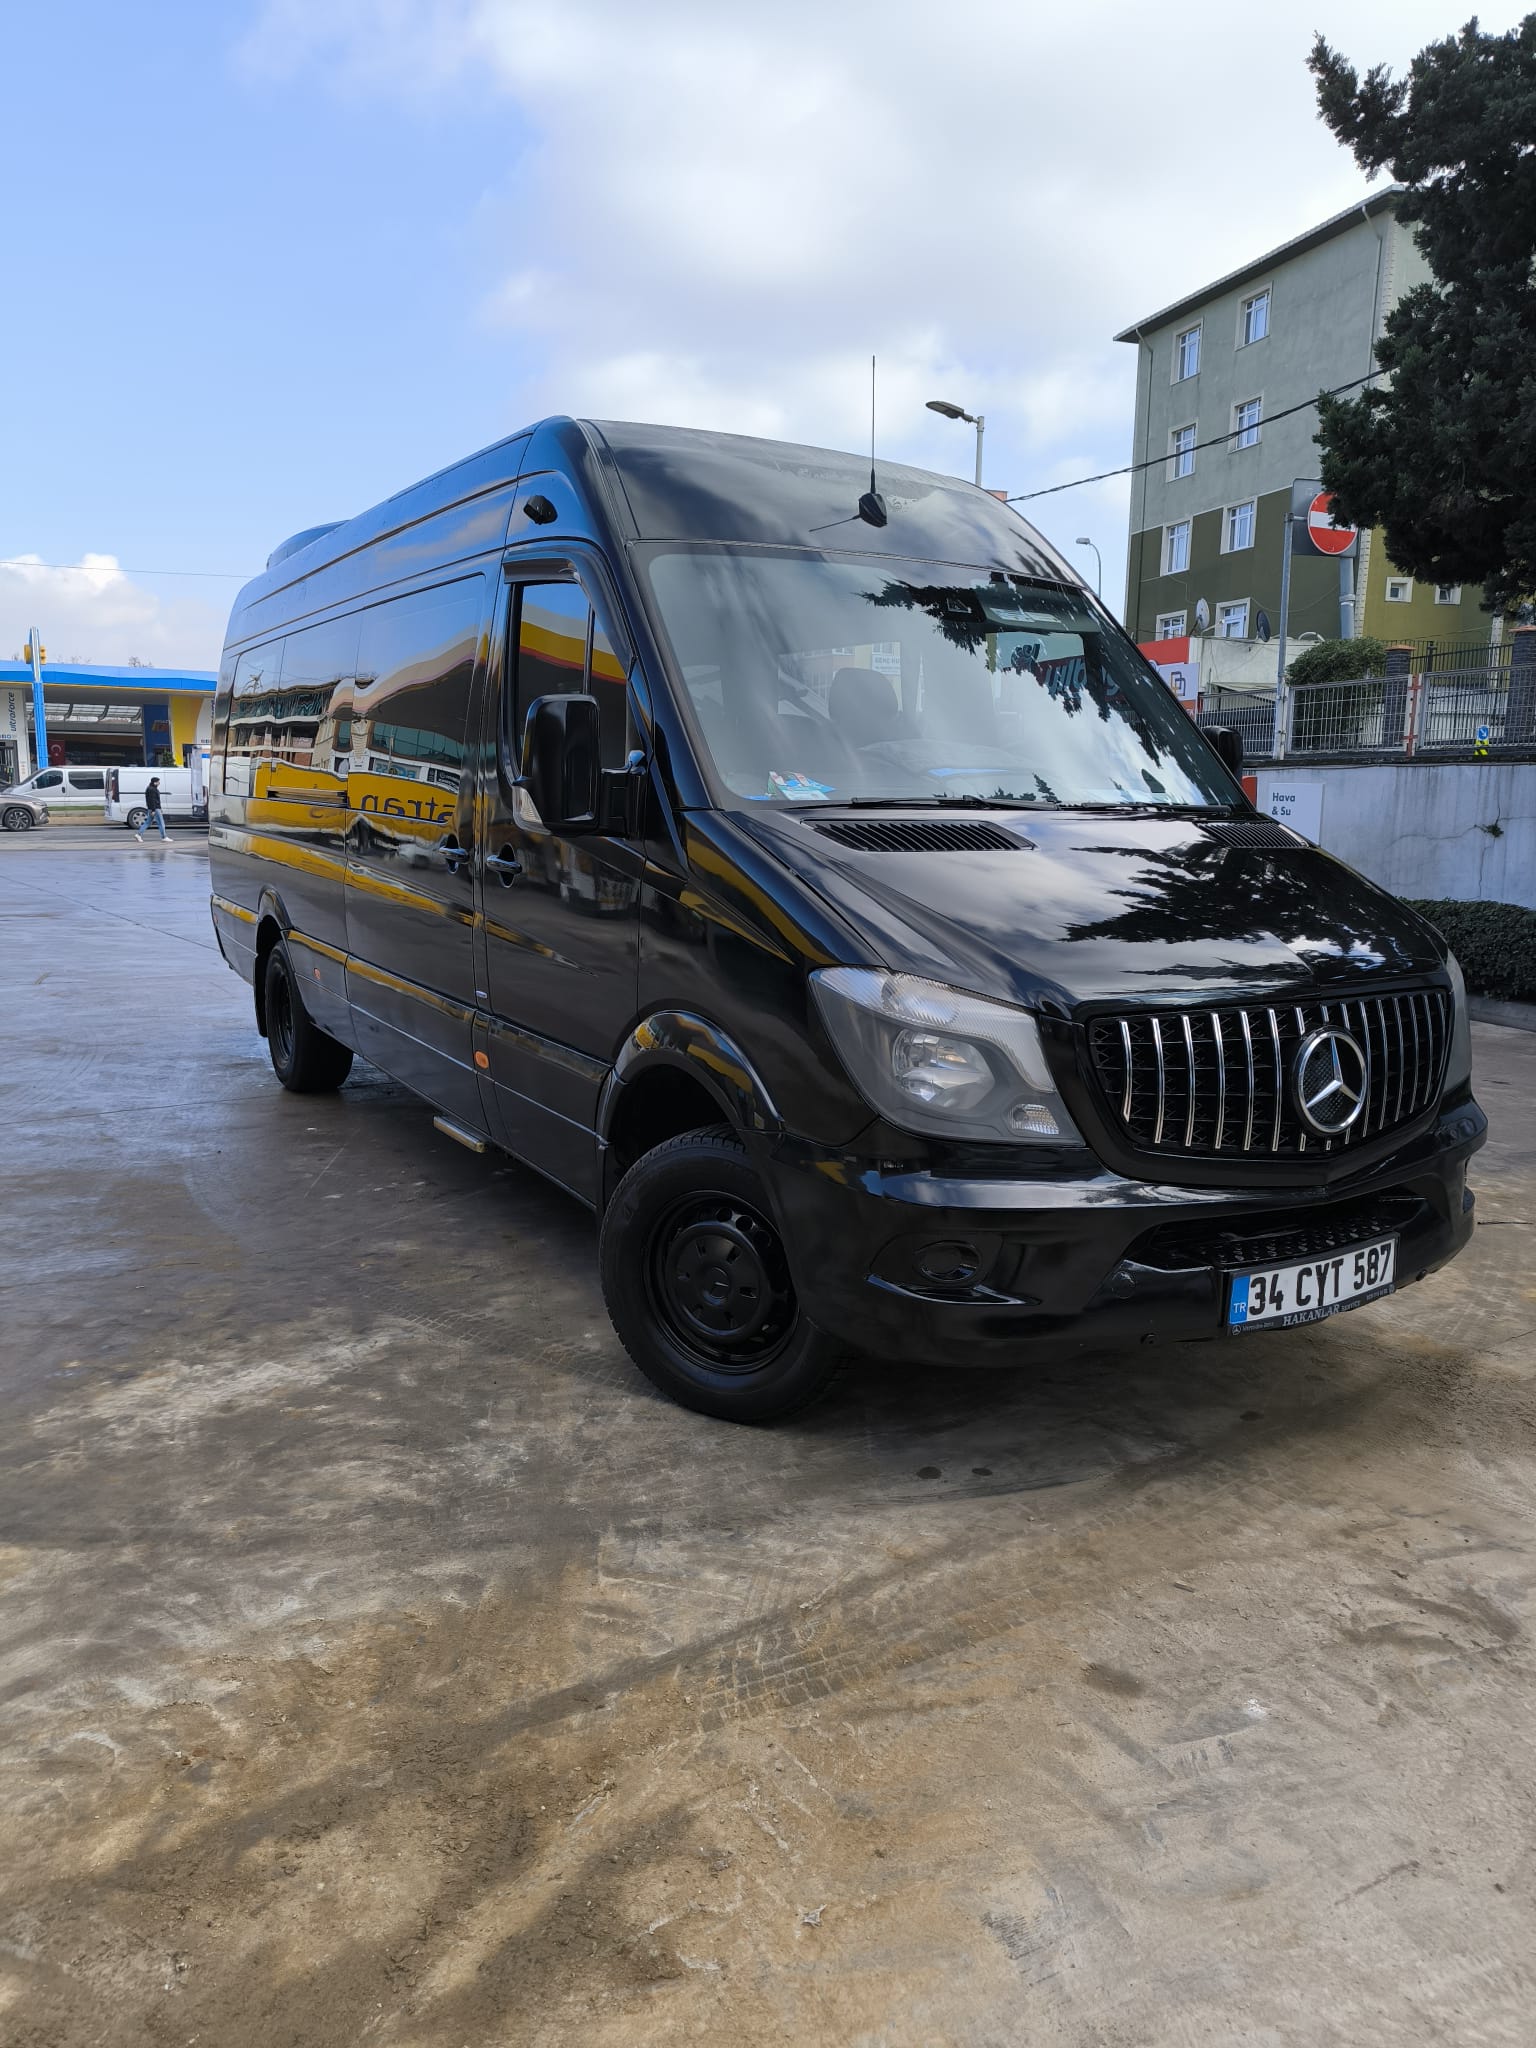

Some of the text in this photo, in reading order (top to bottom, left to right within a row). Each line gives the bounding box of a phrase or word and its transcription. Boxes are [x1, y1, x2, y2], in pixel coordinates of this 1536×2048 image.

[1272, 792, 1296, 802] Hava
[1272, 806, 1291, 816] & Su
[1234, 1243, 1392, 1315] TR 34 CYT 587
[1282, 1304, 1340, 1327] HAKANLAR
